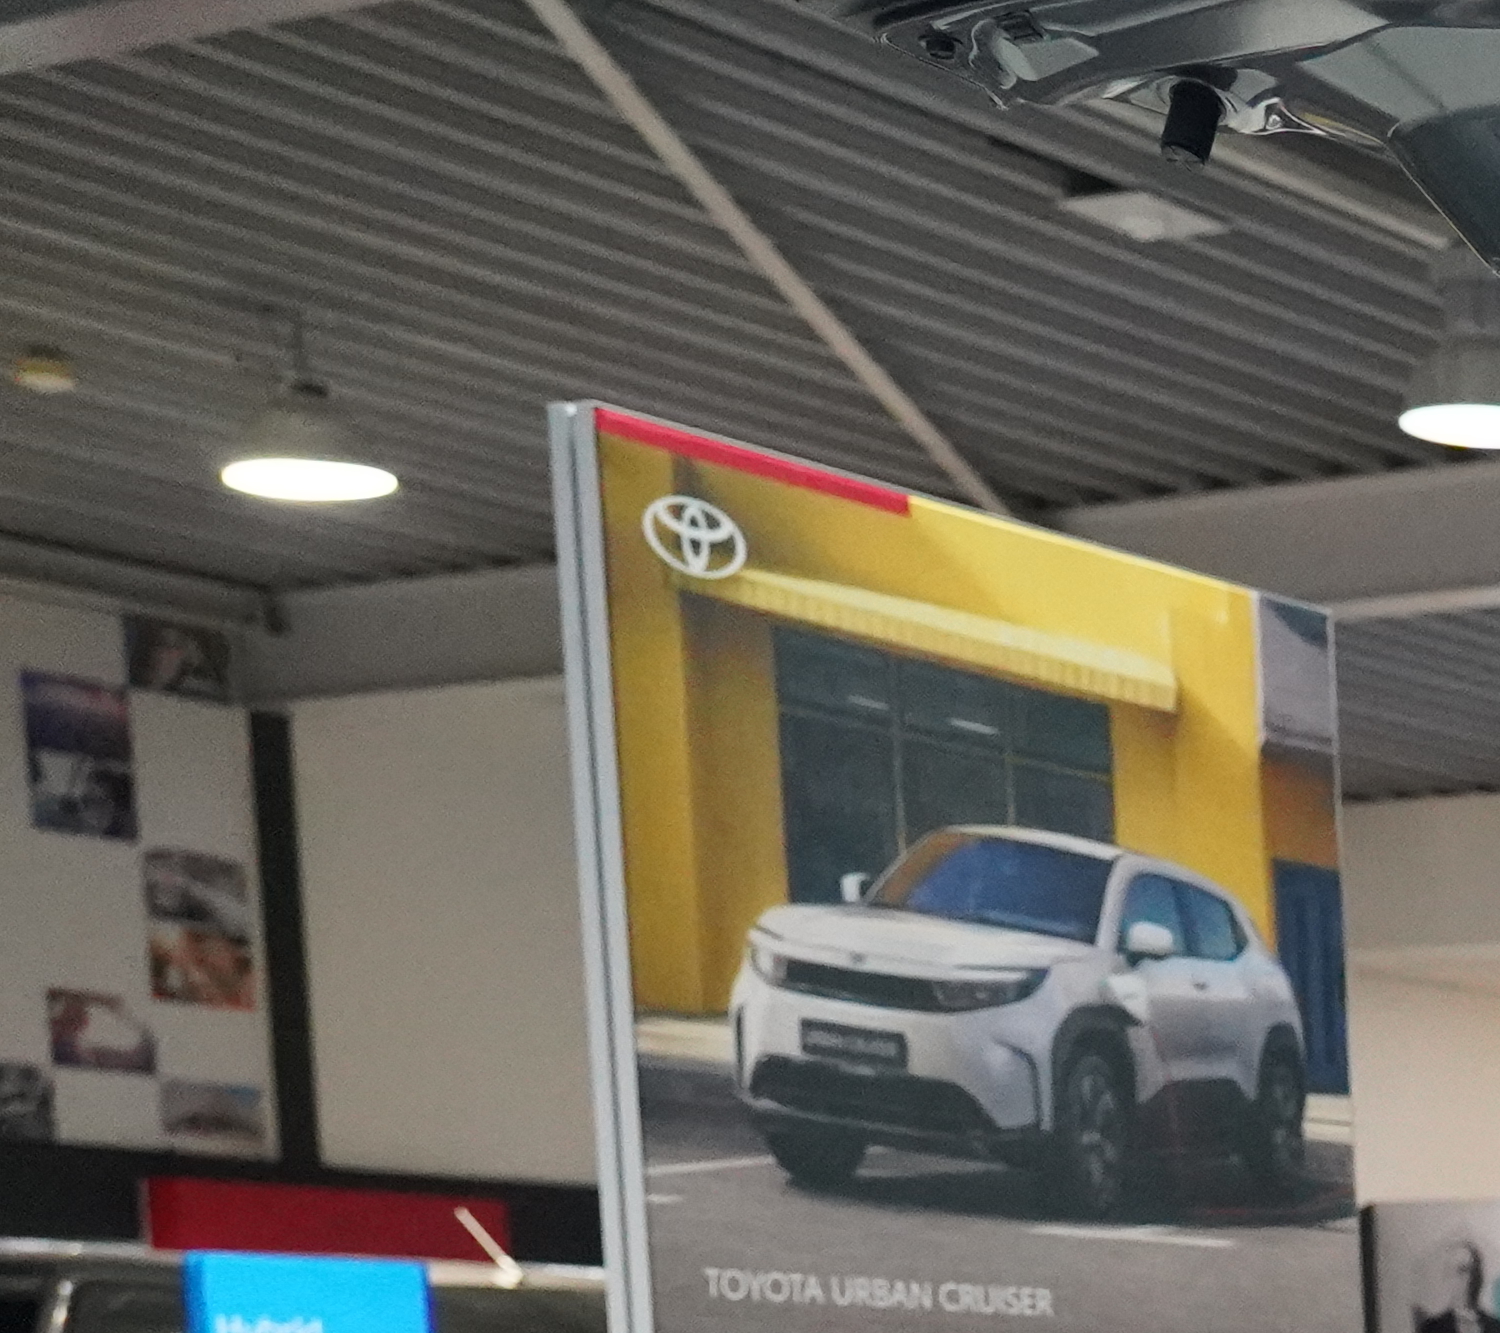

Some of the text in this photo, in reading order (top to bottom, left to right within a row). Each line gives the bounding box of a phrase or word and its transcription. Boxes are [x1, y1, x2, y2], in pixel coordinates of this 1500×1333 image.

[705, 1267, 1054, 1316] TOYOTA URBAN CRUISER
